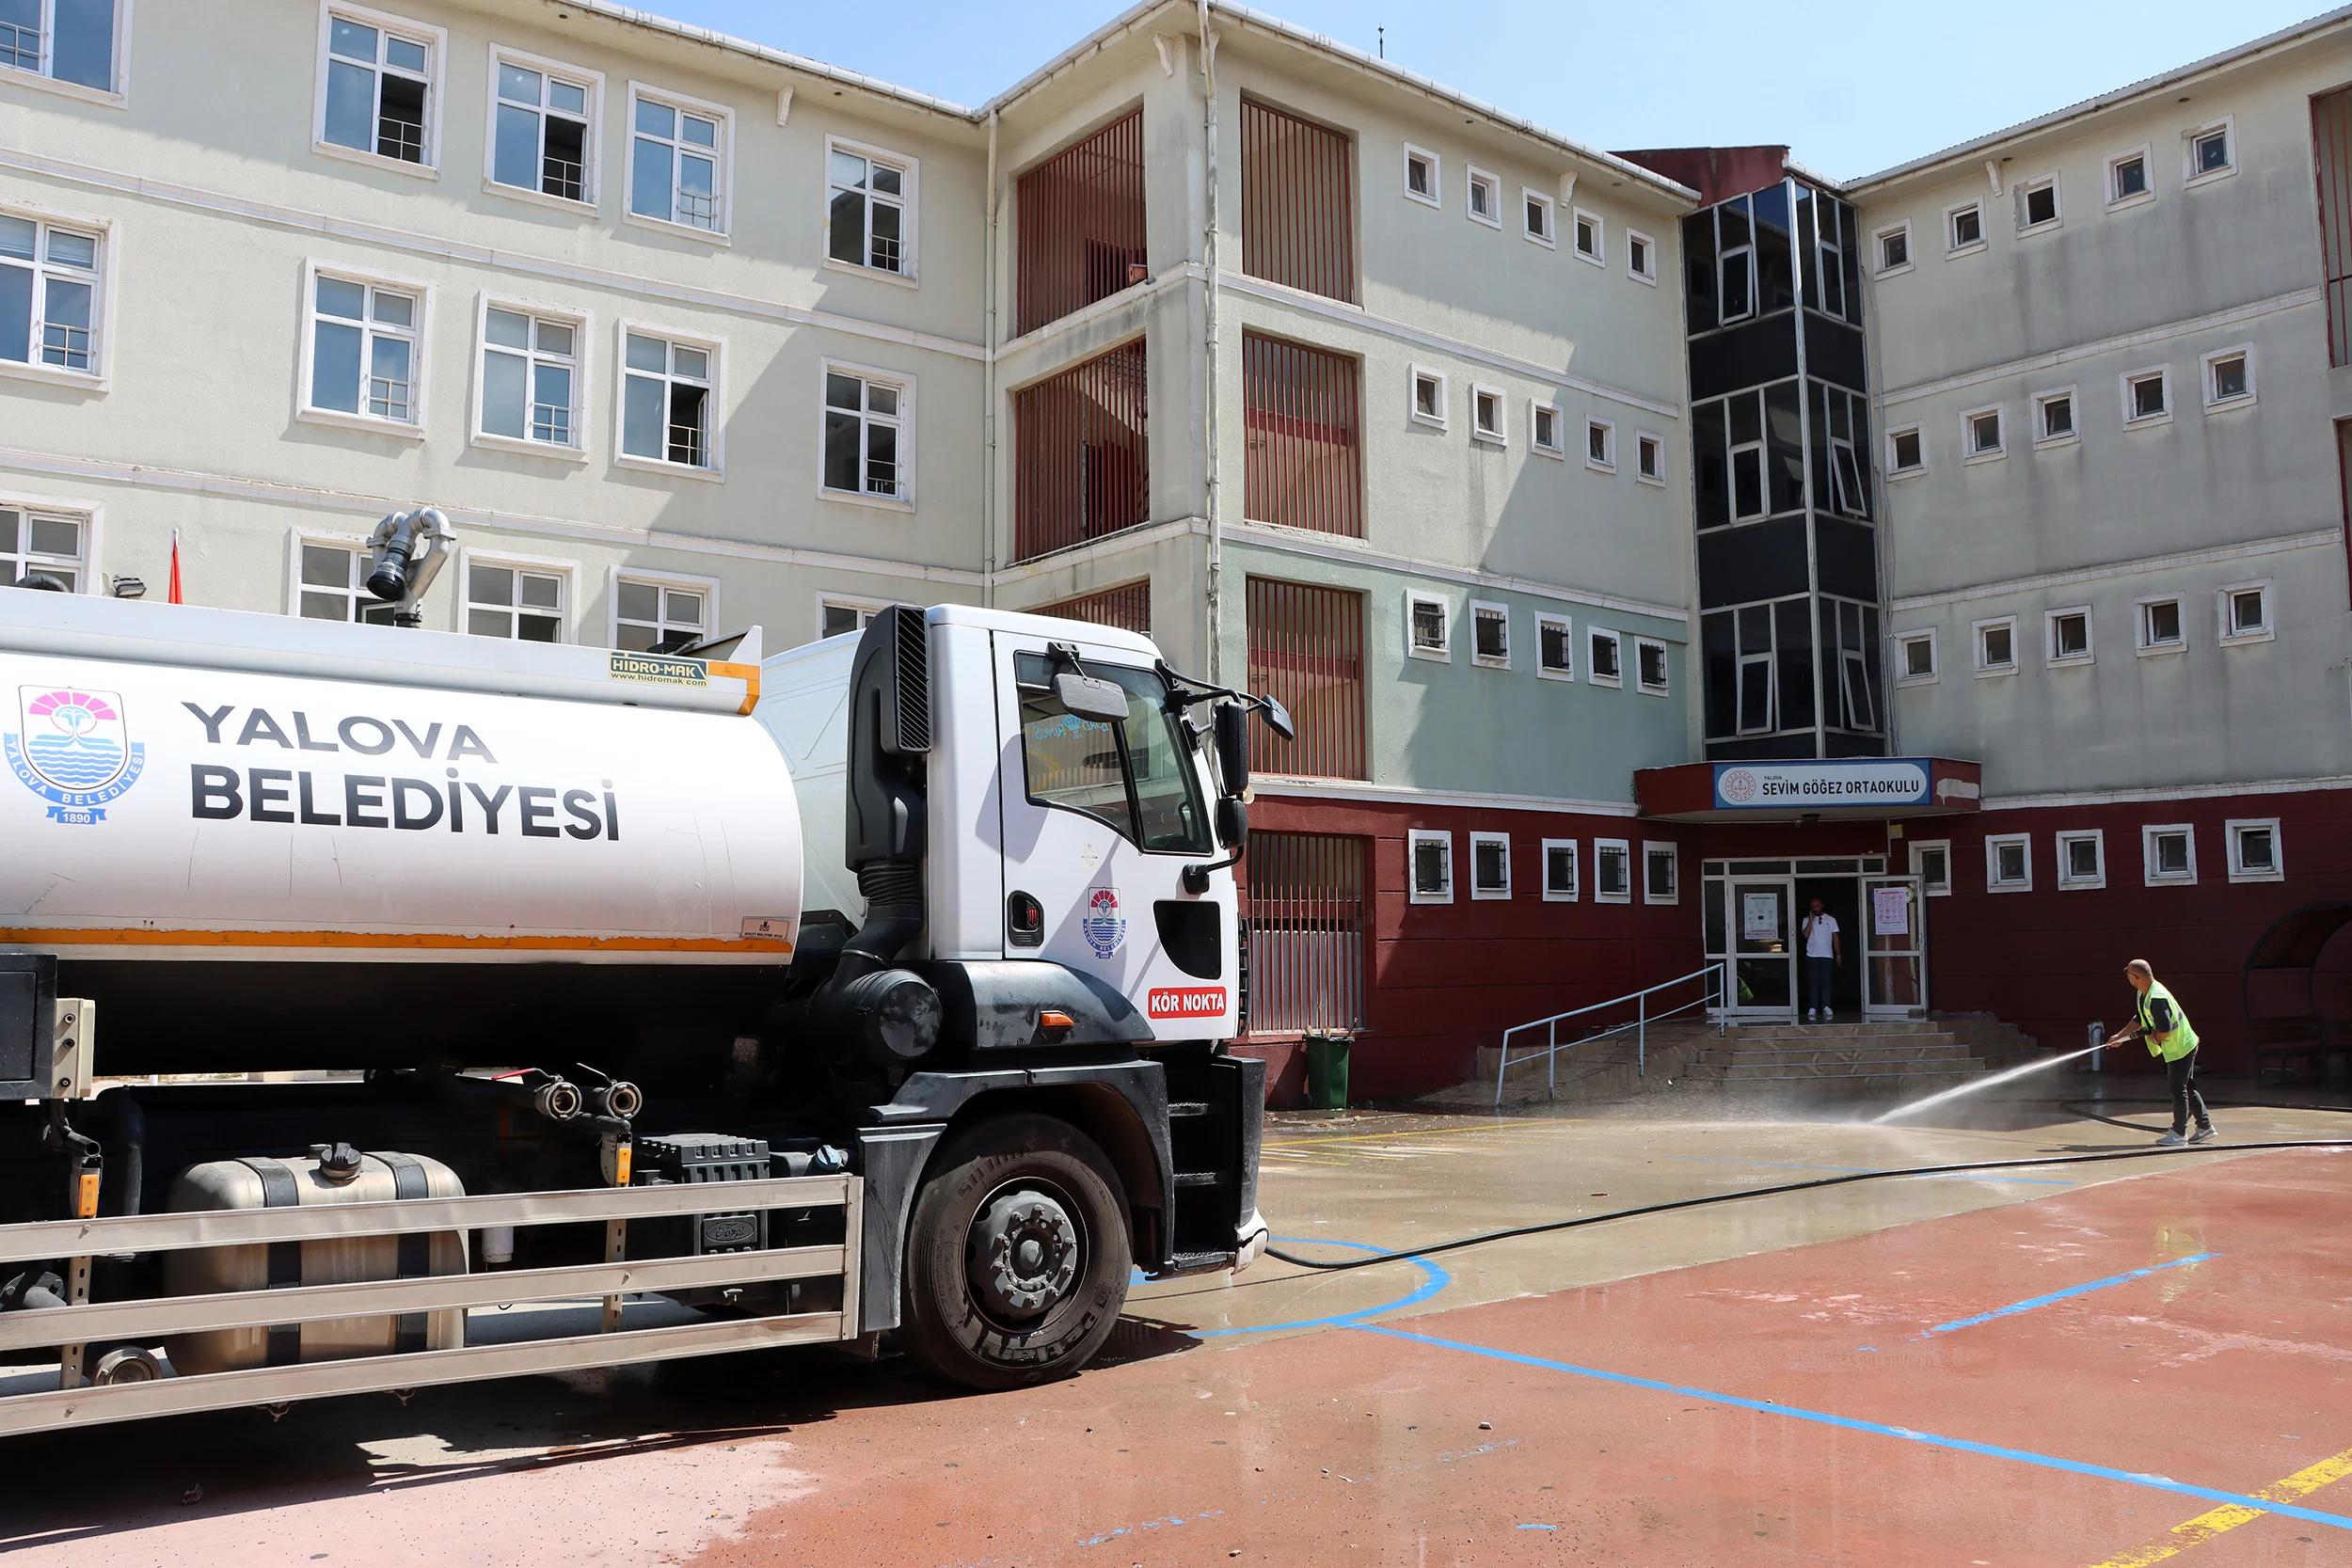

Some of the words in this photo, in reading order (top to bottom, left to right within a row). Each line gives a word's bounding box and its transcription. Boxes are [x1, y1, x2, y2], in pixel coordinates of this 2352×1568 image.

[612, 658, 696, 677] HIDRO-MAK
[181, 701, 499, 764] YALOVA
[6, 741, 47, 795] YALOVA
[61, 752, 144, 804] BELEDİYESİ
[1762, 780, 1800, 795] SEVİM
[1803, 779, 1843, 795] GÖĞEZ
[1845, 780, 1919, 794] ORTAOKULU
[191, 767, 620, 841] BELEDİYESİ
[62, 813, 91, 824] 1890
[1152, 991, 1180, 1012] KÖR
[1184, 993, 1225, 1011] NOKTA
[716, 1223, 745, 1239] Ford
